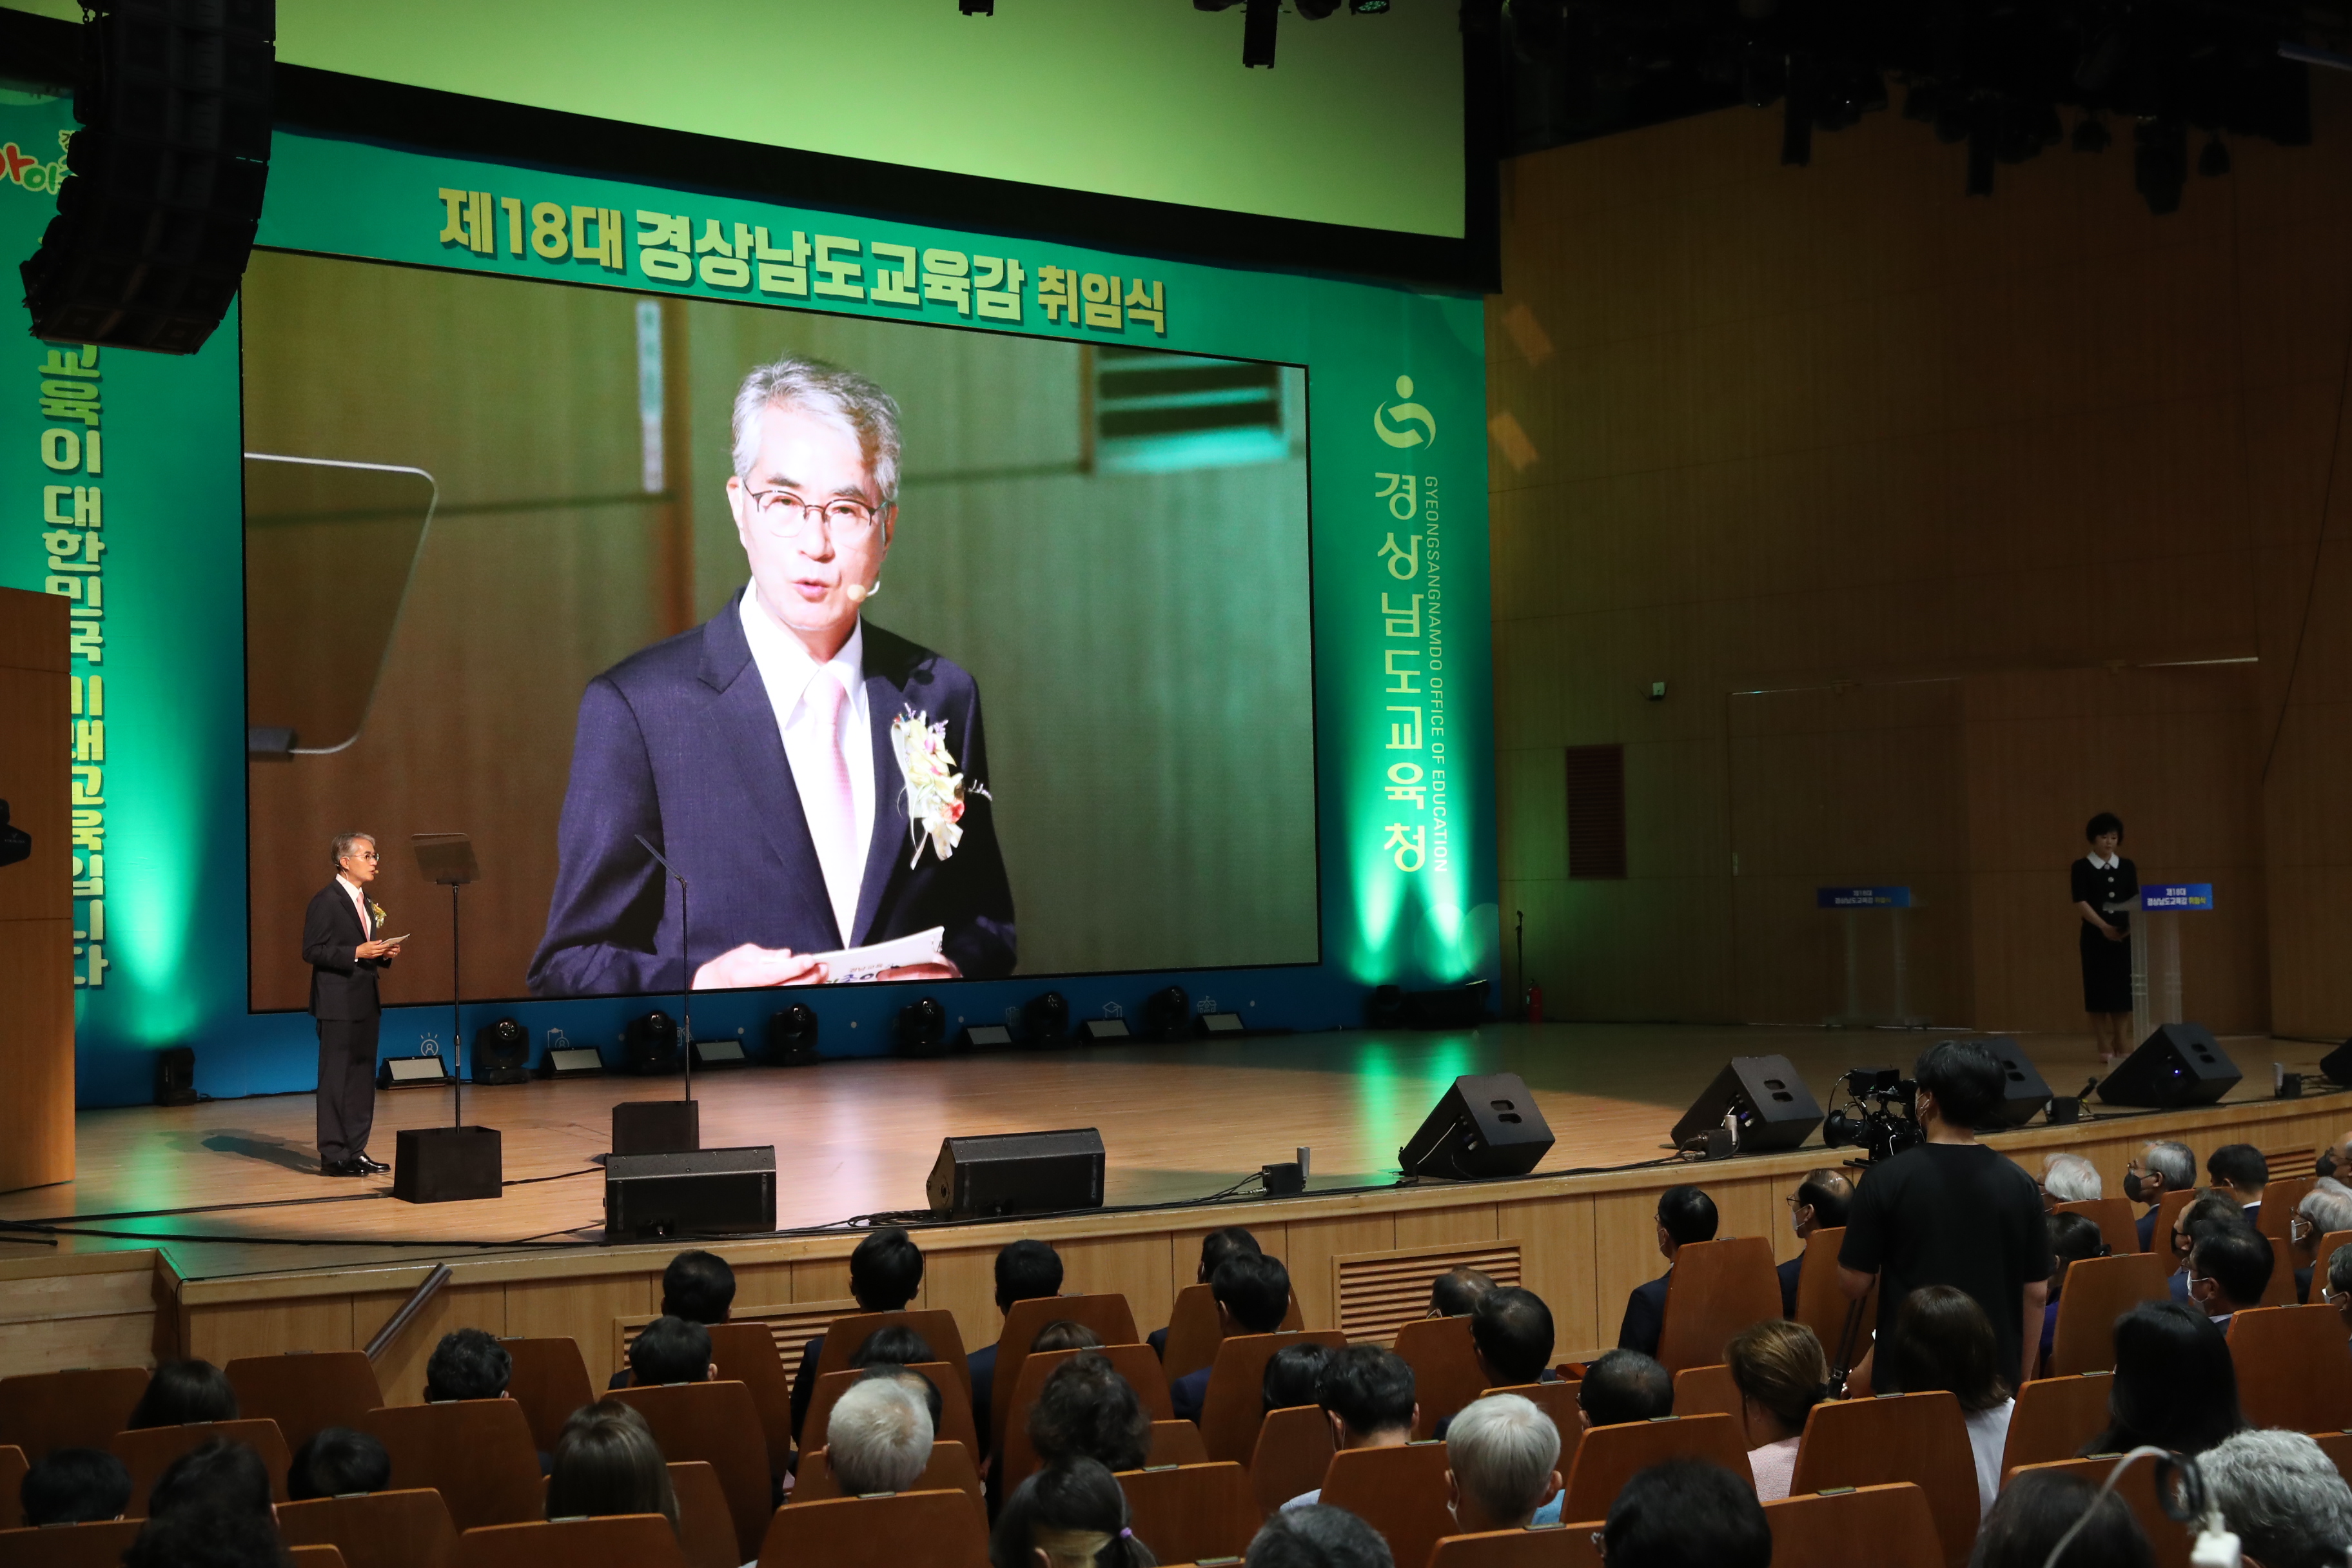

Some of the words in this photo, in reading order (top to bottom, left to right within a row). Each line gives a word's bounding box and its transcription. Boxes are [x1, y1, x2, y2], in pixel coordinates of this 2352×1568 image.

[439, 187, 623, 269] 제18대
[636, 209, 1024, 320] 경상남도교육감
[1038, 265, 1164, 333] 취임식
[1425, 476, 1443, 671] GYEONGSANGNAMDO
[1375, 472, 1427, 872] 경상남도교육청
[1430, 678, 1444, 736] OFFICE
[1431, 743, 1445, 765] OF
[1432, 770, 1448, 872] EDUCATION
